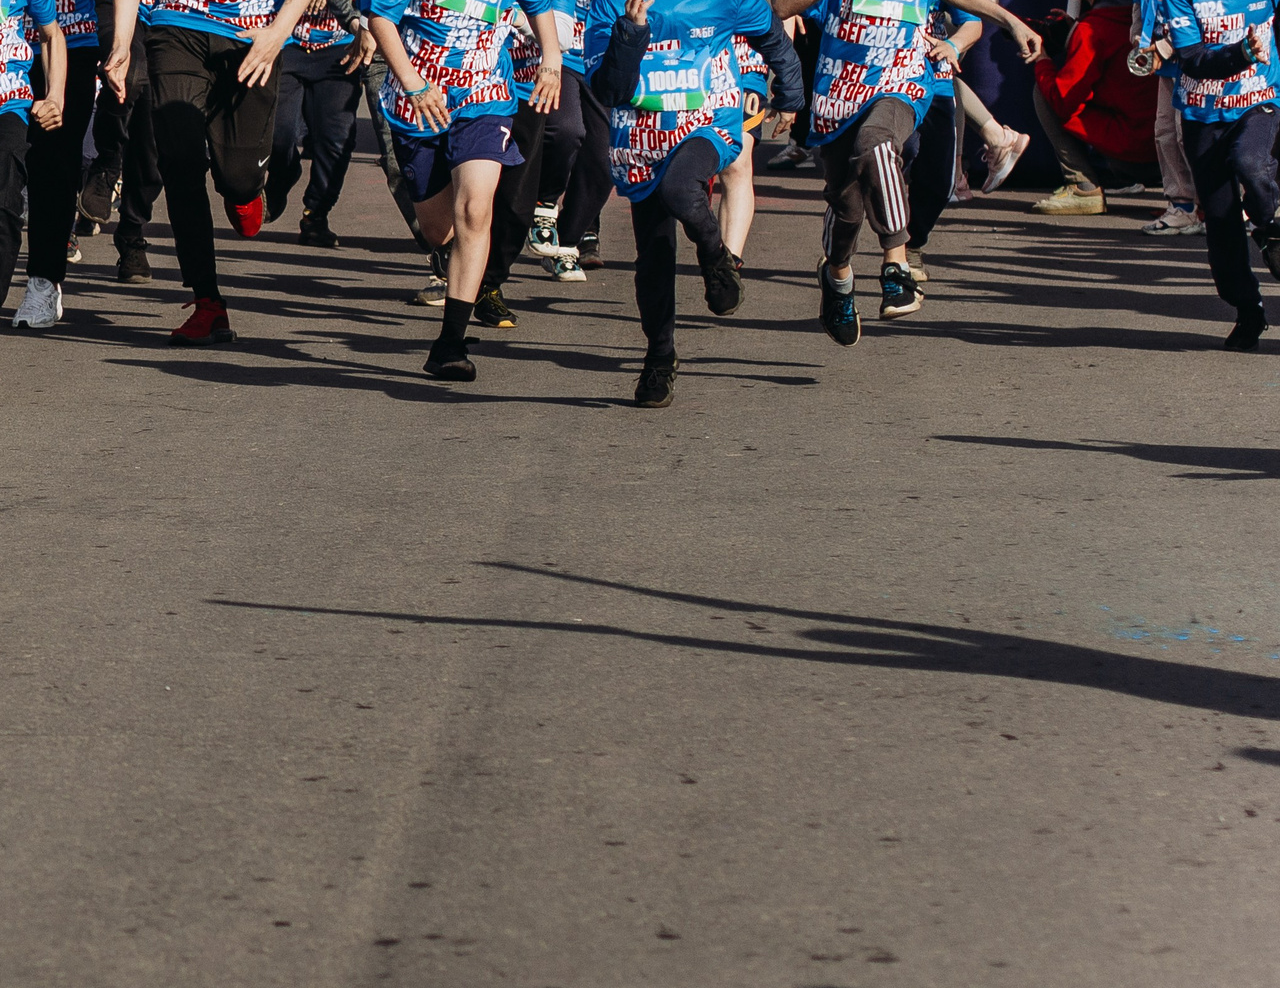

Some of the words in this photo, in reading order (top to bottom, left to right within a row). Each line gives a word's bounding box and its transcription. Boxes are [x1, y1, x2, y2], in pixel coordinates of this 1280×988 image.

[1193, 0, 1226, 19] 2024
[647, 68, 699, 92] 10046
[818, 53, 869, 84] #ЗАБЕГ
